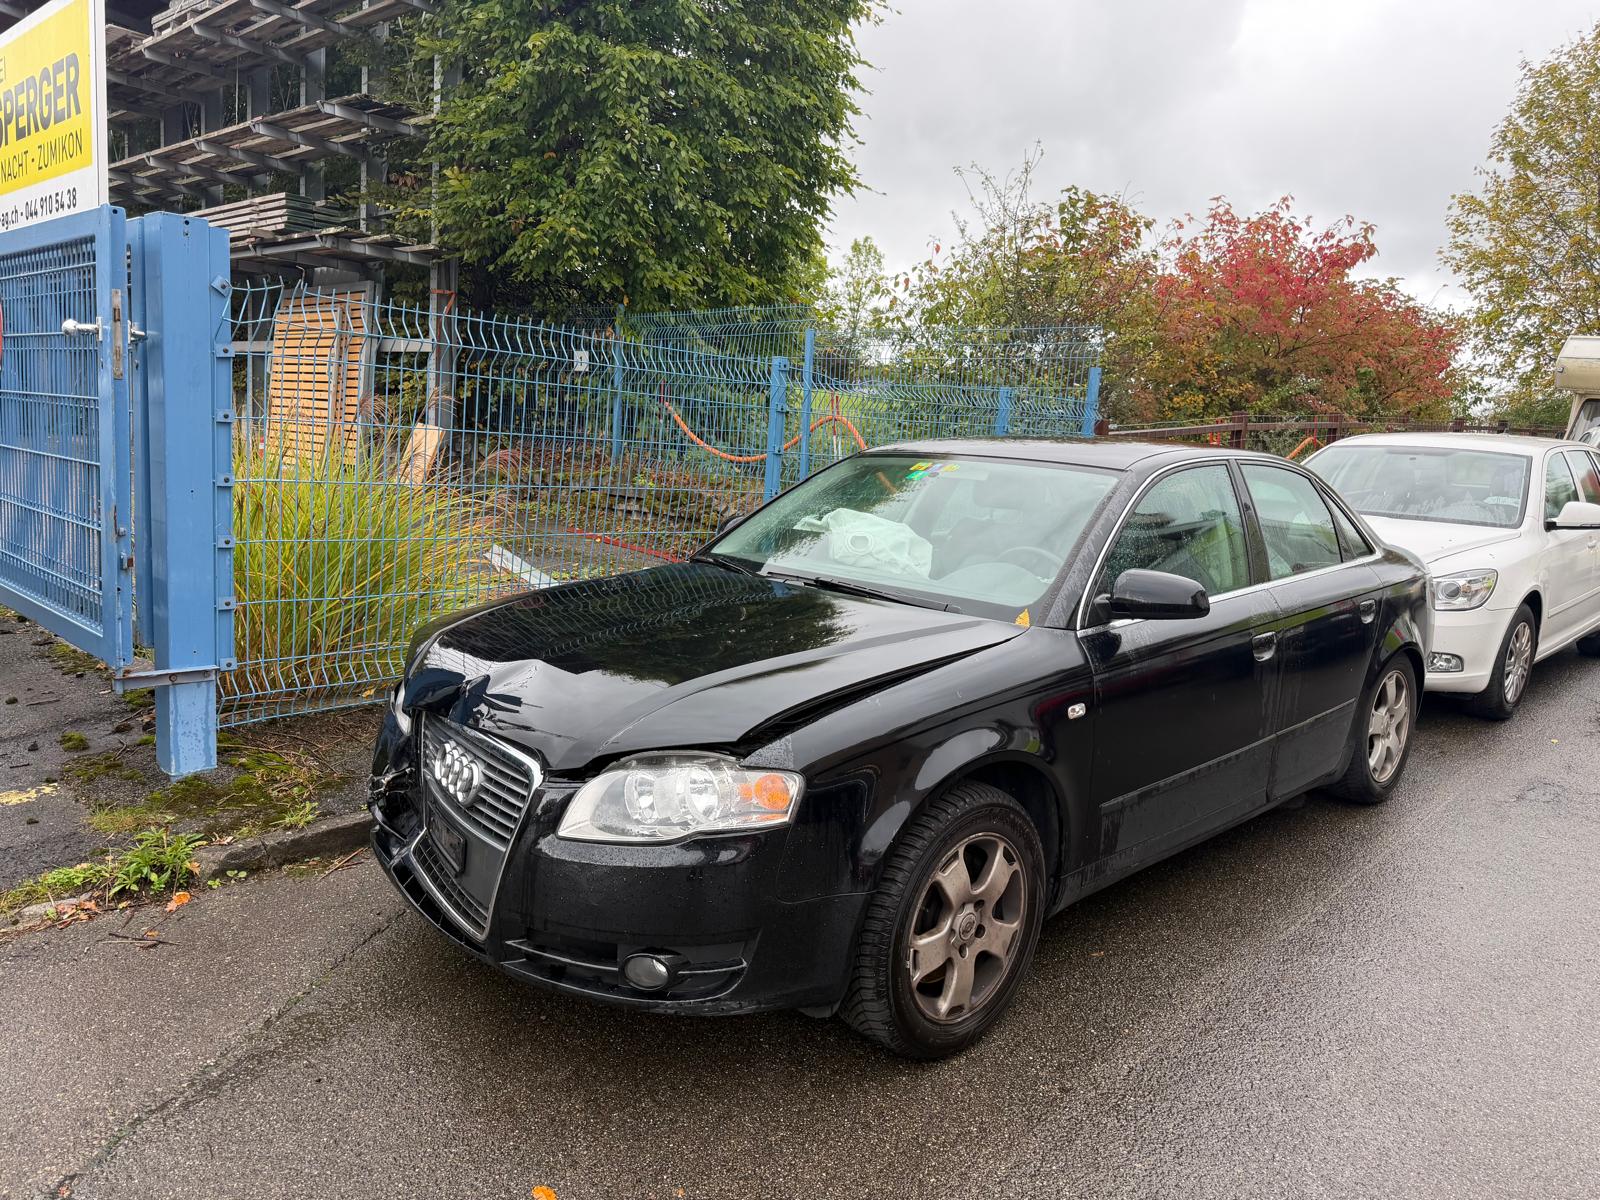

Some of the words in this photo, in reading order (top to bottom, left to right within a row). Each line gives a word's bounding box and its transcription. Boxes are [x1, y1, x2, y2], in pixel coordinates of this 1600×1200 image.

[1, 149, 29, 184] NACHT
[37, 128, 83, 171] ZUMIKON
[25, 199, 38, 221] 044
[39, 194, 53, 217] 910
[54, 190, 65, 213] 54
[66, 186, 77, 210] 38
